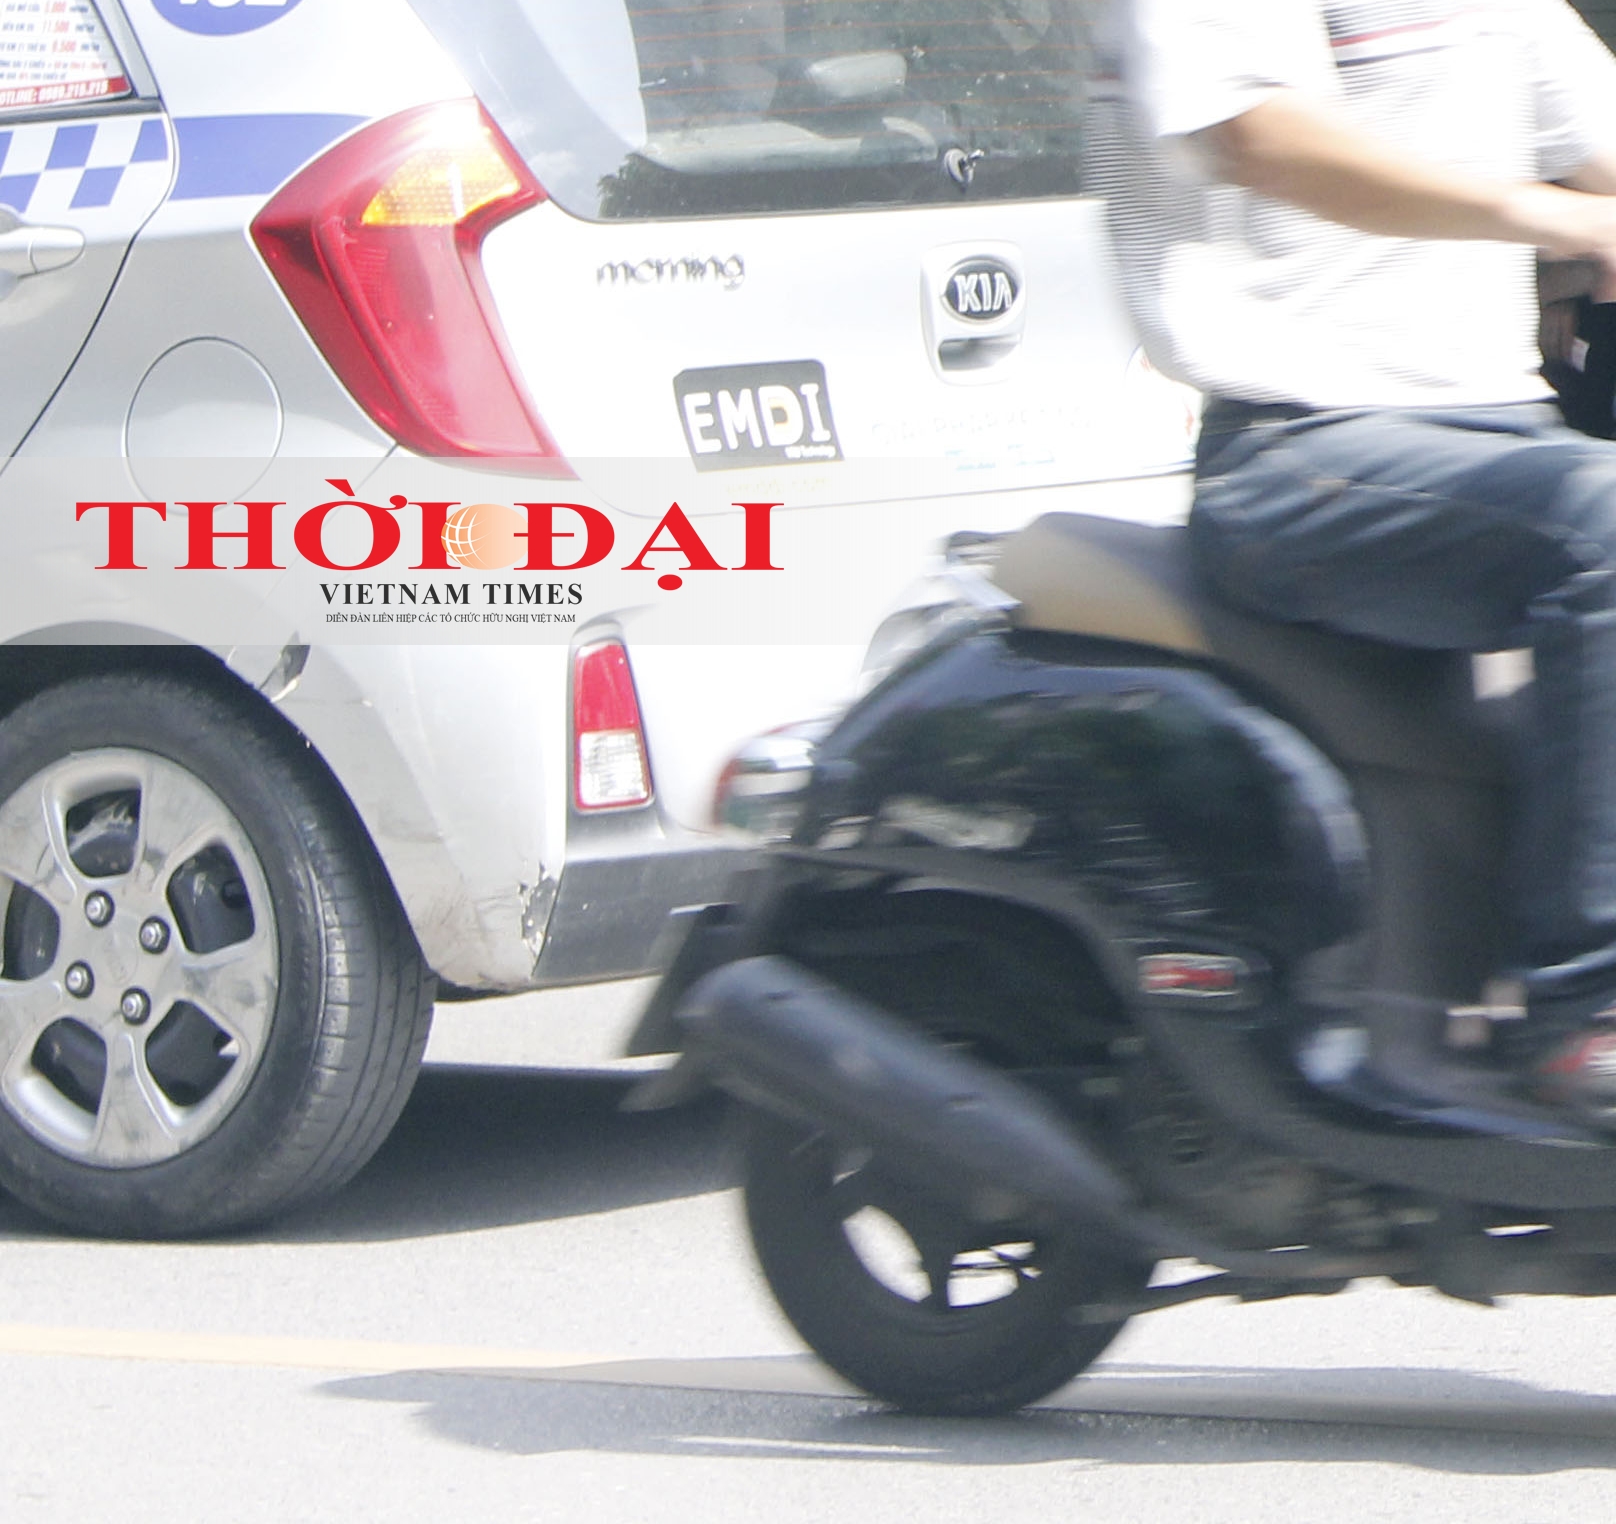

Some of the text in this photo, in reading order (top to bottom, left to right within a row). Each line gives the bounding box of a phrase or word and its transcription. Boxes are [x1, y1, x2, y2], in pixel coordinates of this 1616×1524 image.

[597, 253, 745, 291] morning
[954, 272, 1014, 314] KIA
[683, 382, 832, 455] EMDI
